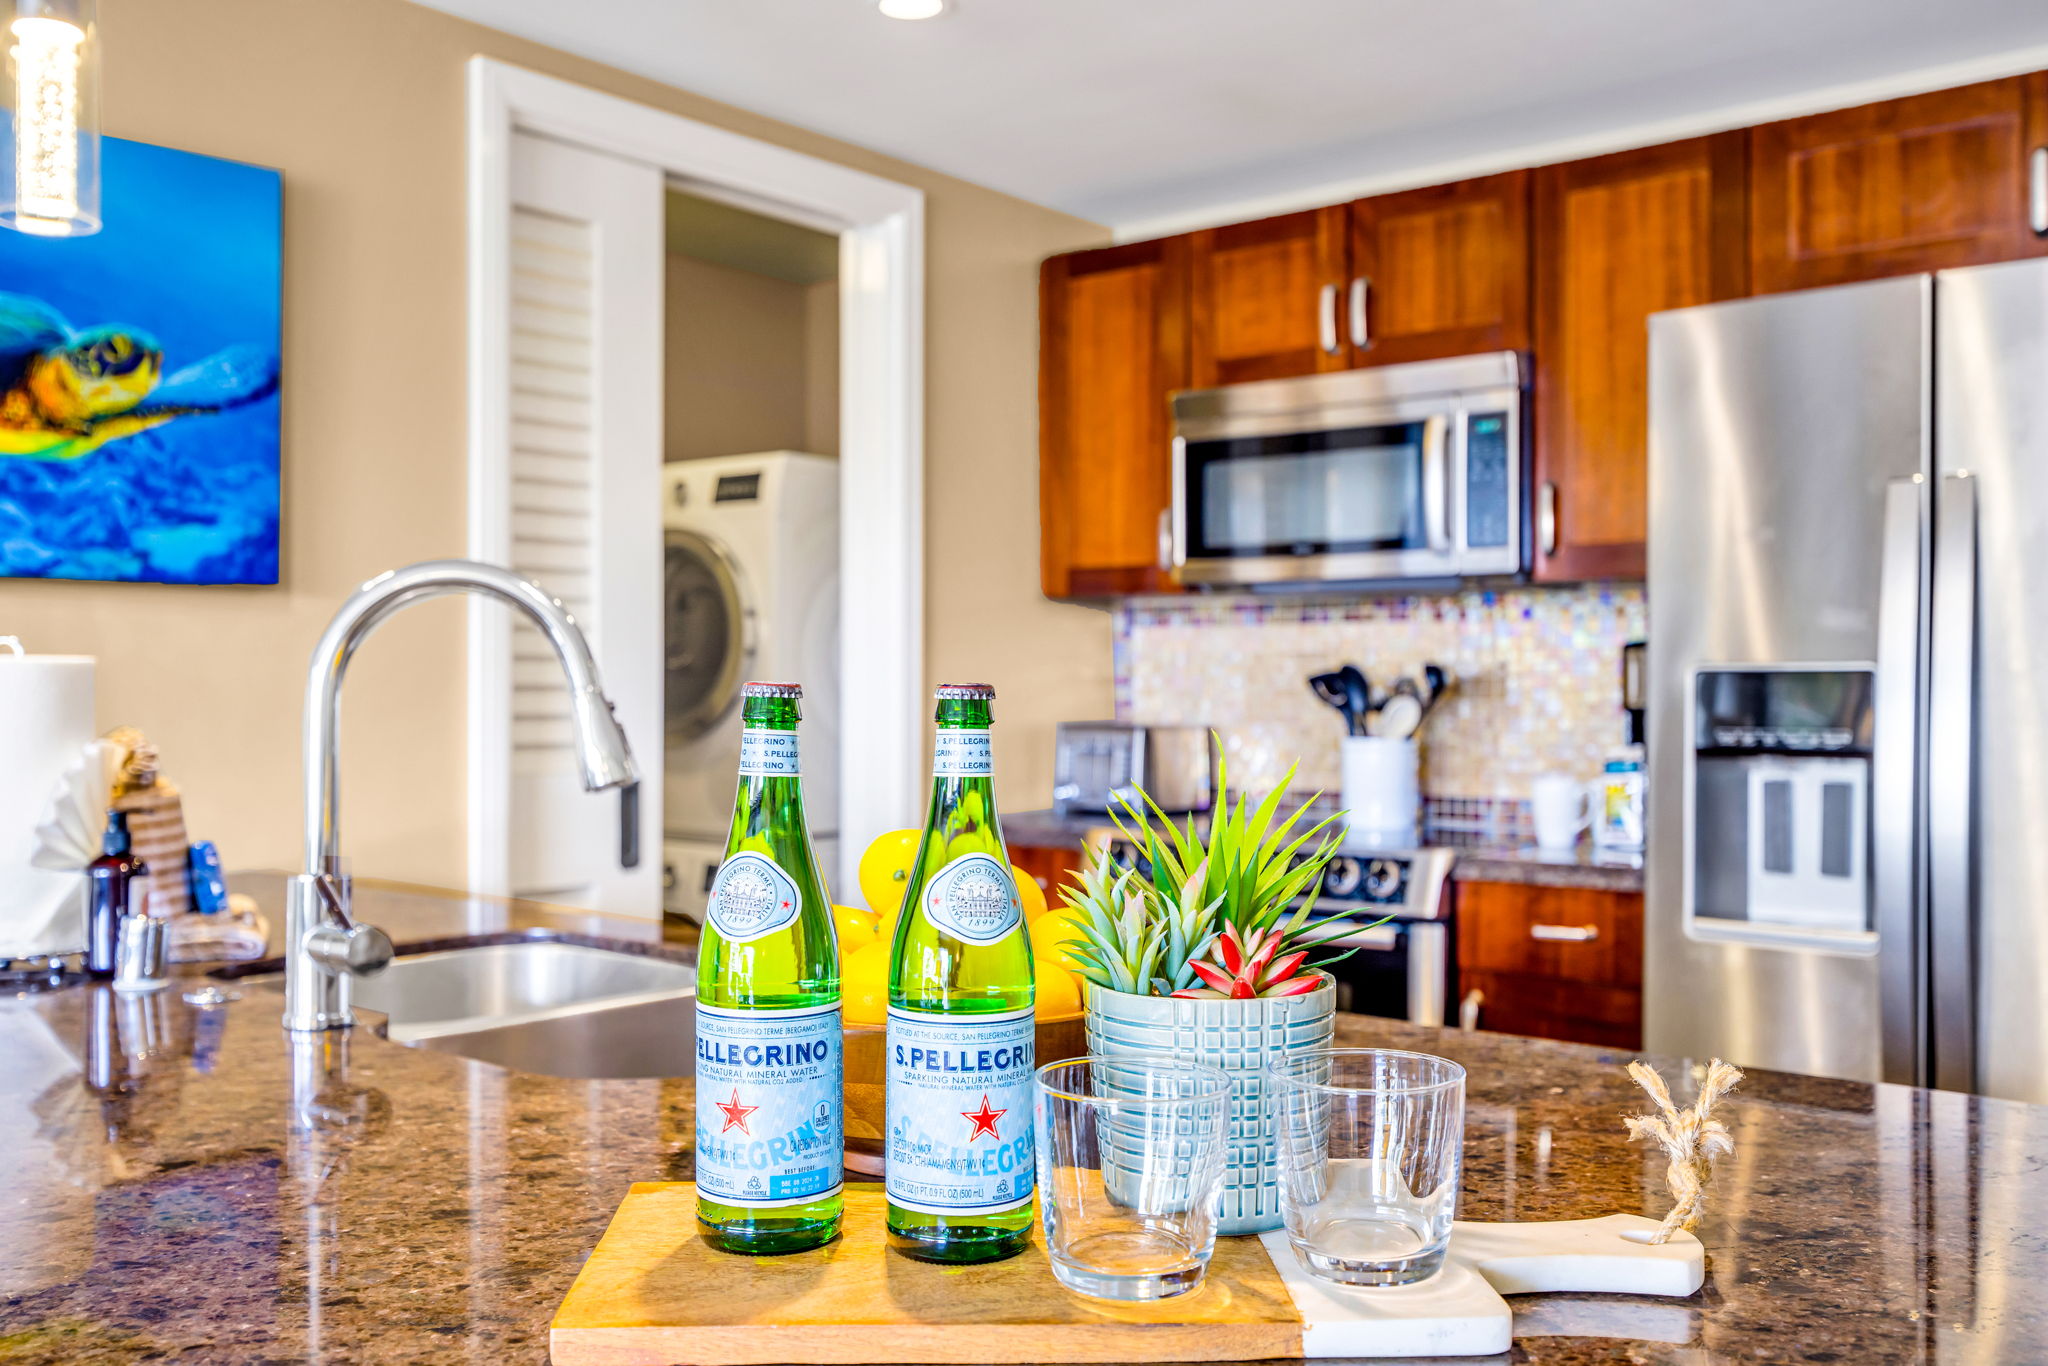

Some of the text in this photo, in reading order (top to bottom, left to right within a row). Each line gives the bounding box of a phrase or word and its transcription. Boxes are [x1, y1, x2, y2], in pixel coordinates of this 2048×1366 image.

[753, 867, 773, 888] TERME
[949, 867, 1008, 921] SAN PELLEGRINO TERME ITALIA
[756, 898, 773, 920] ITALIA
[968, 919, 995, 927] 1899
[764, 1027, 784, 1036] TERME
[913, 1030, 920, 1038] AT
[921, 1031, 931, 1039] THE
[961, 1033, 976, 1041] SAN
[977, 1030, 1011, 1040] PELLEGRINO
[710, 1066, 743, 1078] NATURAL
[746, 1070, 788, 1079] MINERAL
[790, 1065, 818, 1077] WATER
[904, 1071, 949, 1084] SPARKLING
[952, 1075, 993, 1085] NATURAL
[996, 1068, 1026, 1082] MINERAL
[821, 1104, 826, 1116] 0
[784, 1167, 796, 1175] BEST
[929, 1187, 938, 1198] 0.9
[939, 1188, 947, 1198] FL
[947, 1188, 958, 1200] OZ)
[959, 1188, 972, 1200] (500
[973, 1188, 984, 1199] mL)
